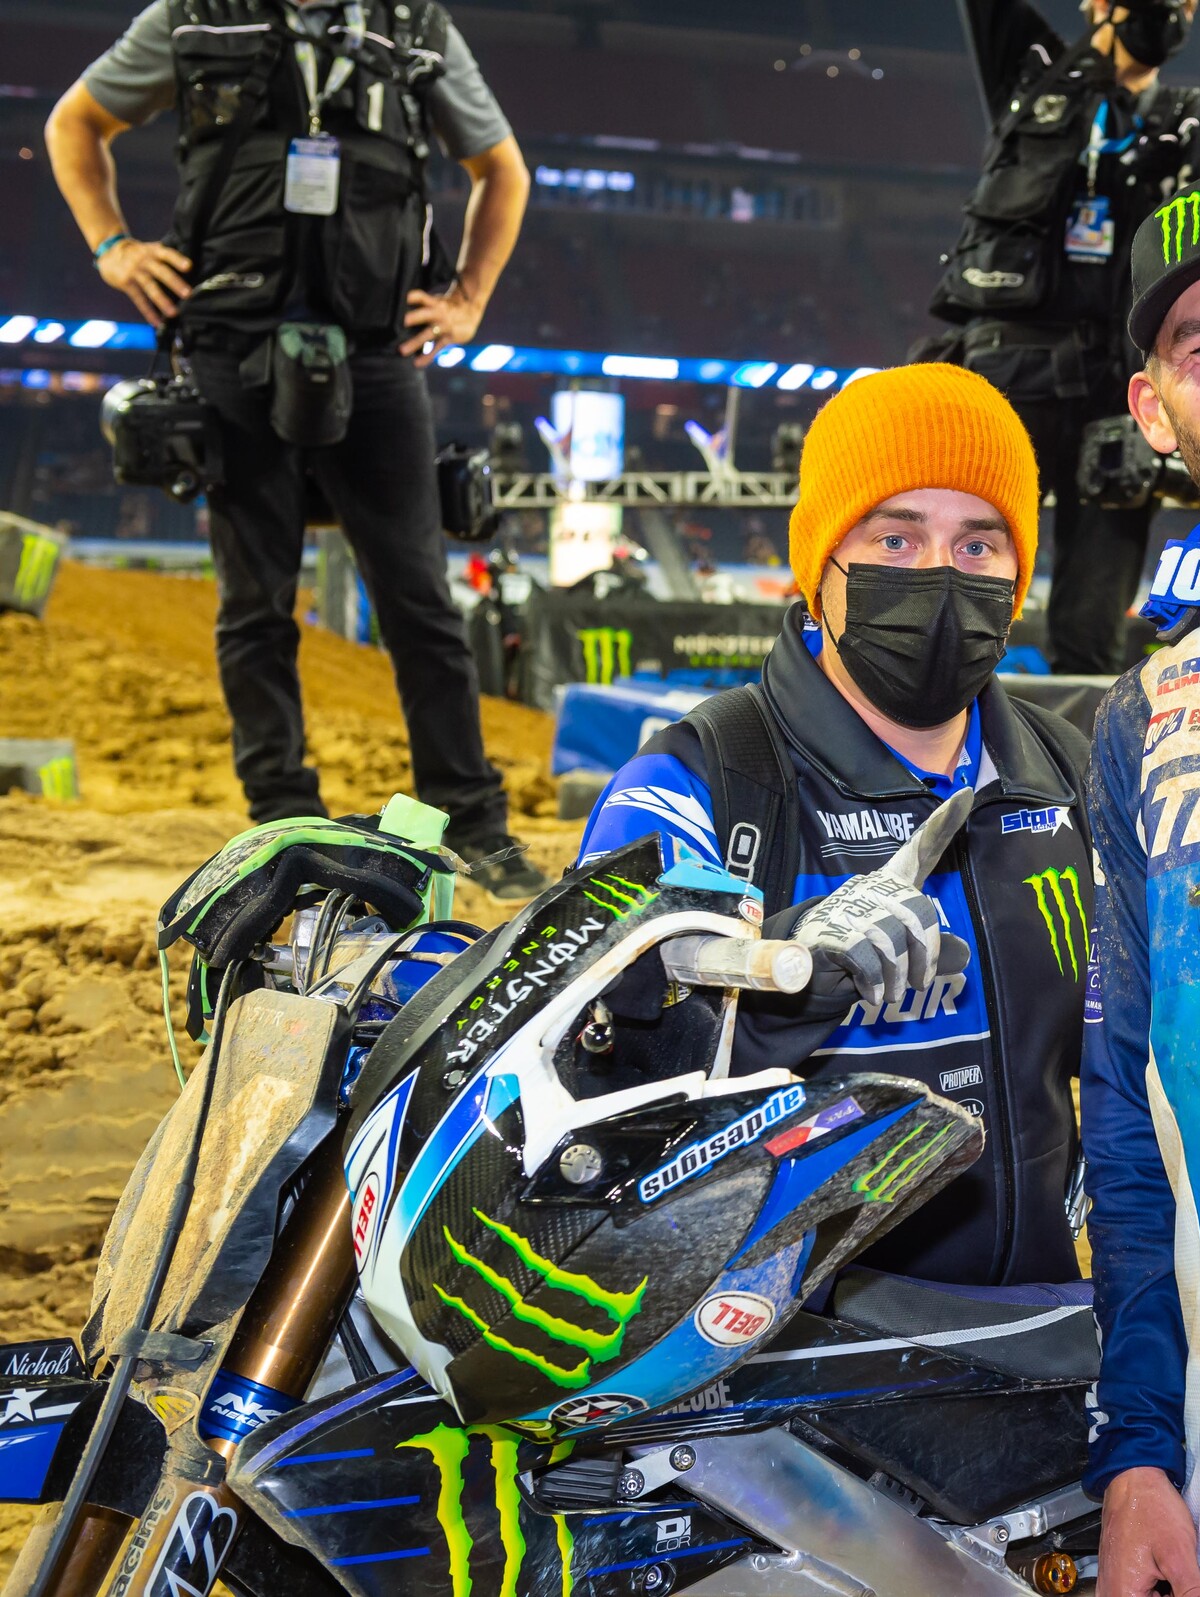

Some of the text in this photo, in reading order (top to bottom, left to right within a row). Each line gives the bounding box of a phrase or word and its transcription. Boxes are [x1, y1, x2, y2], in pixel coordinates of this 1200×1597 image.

[367, 82, 384, 131] 1
[1143, 711, 1178, 752] 00%
[817, 810, 915, 842] YAMALUBE
[456, 925, 558, 1031] ENERGY
[943, 1067, 980, 1090] PROTAPER
[711, 1300, 766, 1336] BELL
[4, 1345, 72, 1377] Nichols
[210, 1405, 263, 1429] NEKE
[110, 1480, 177, 1597] acing
